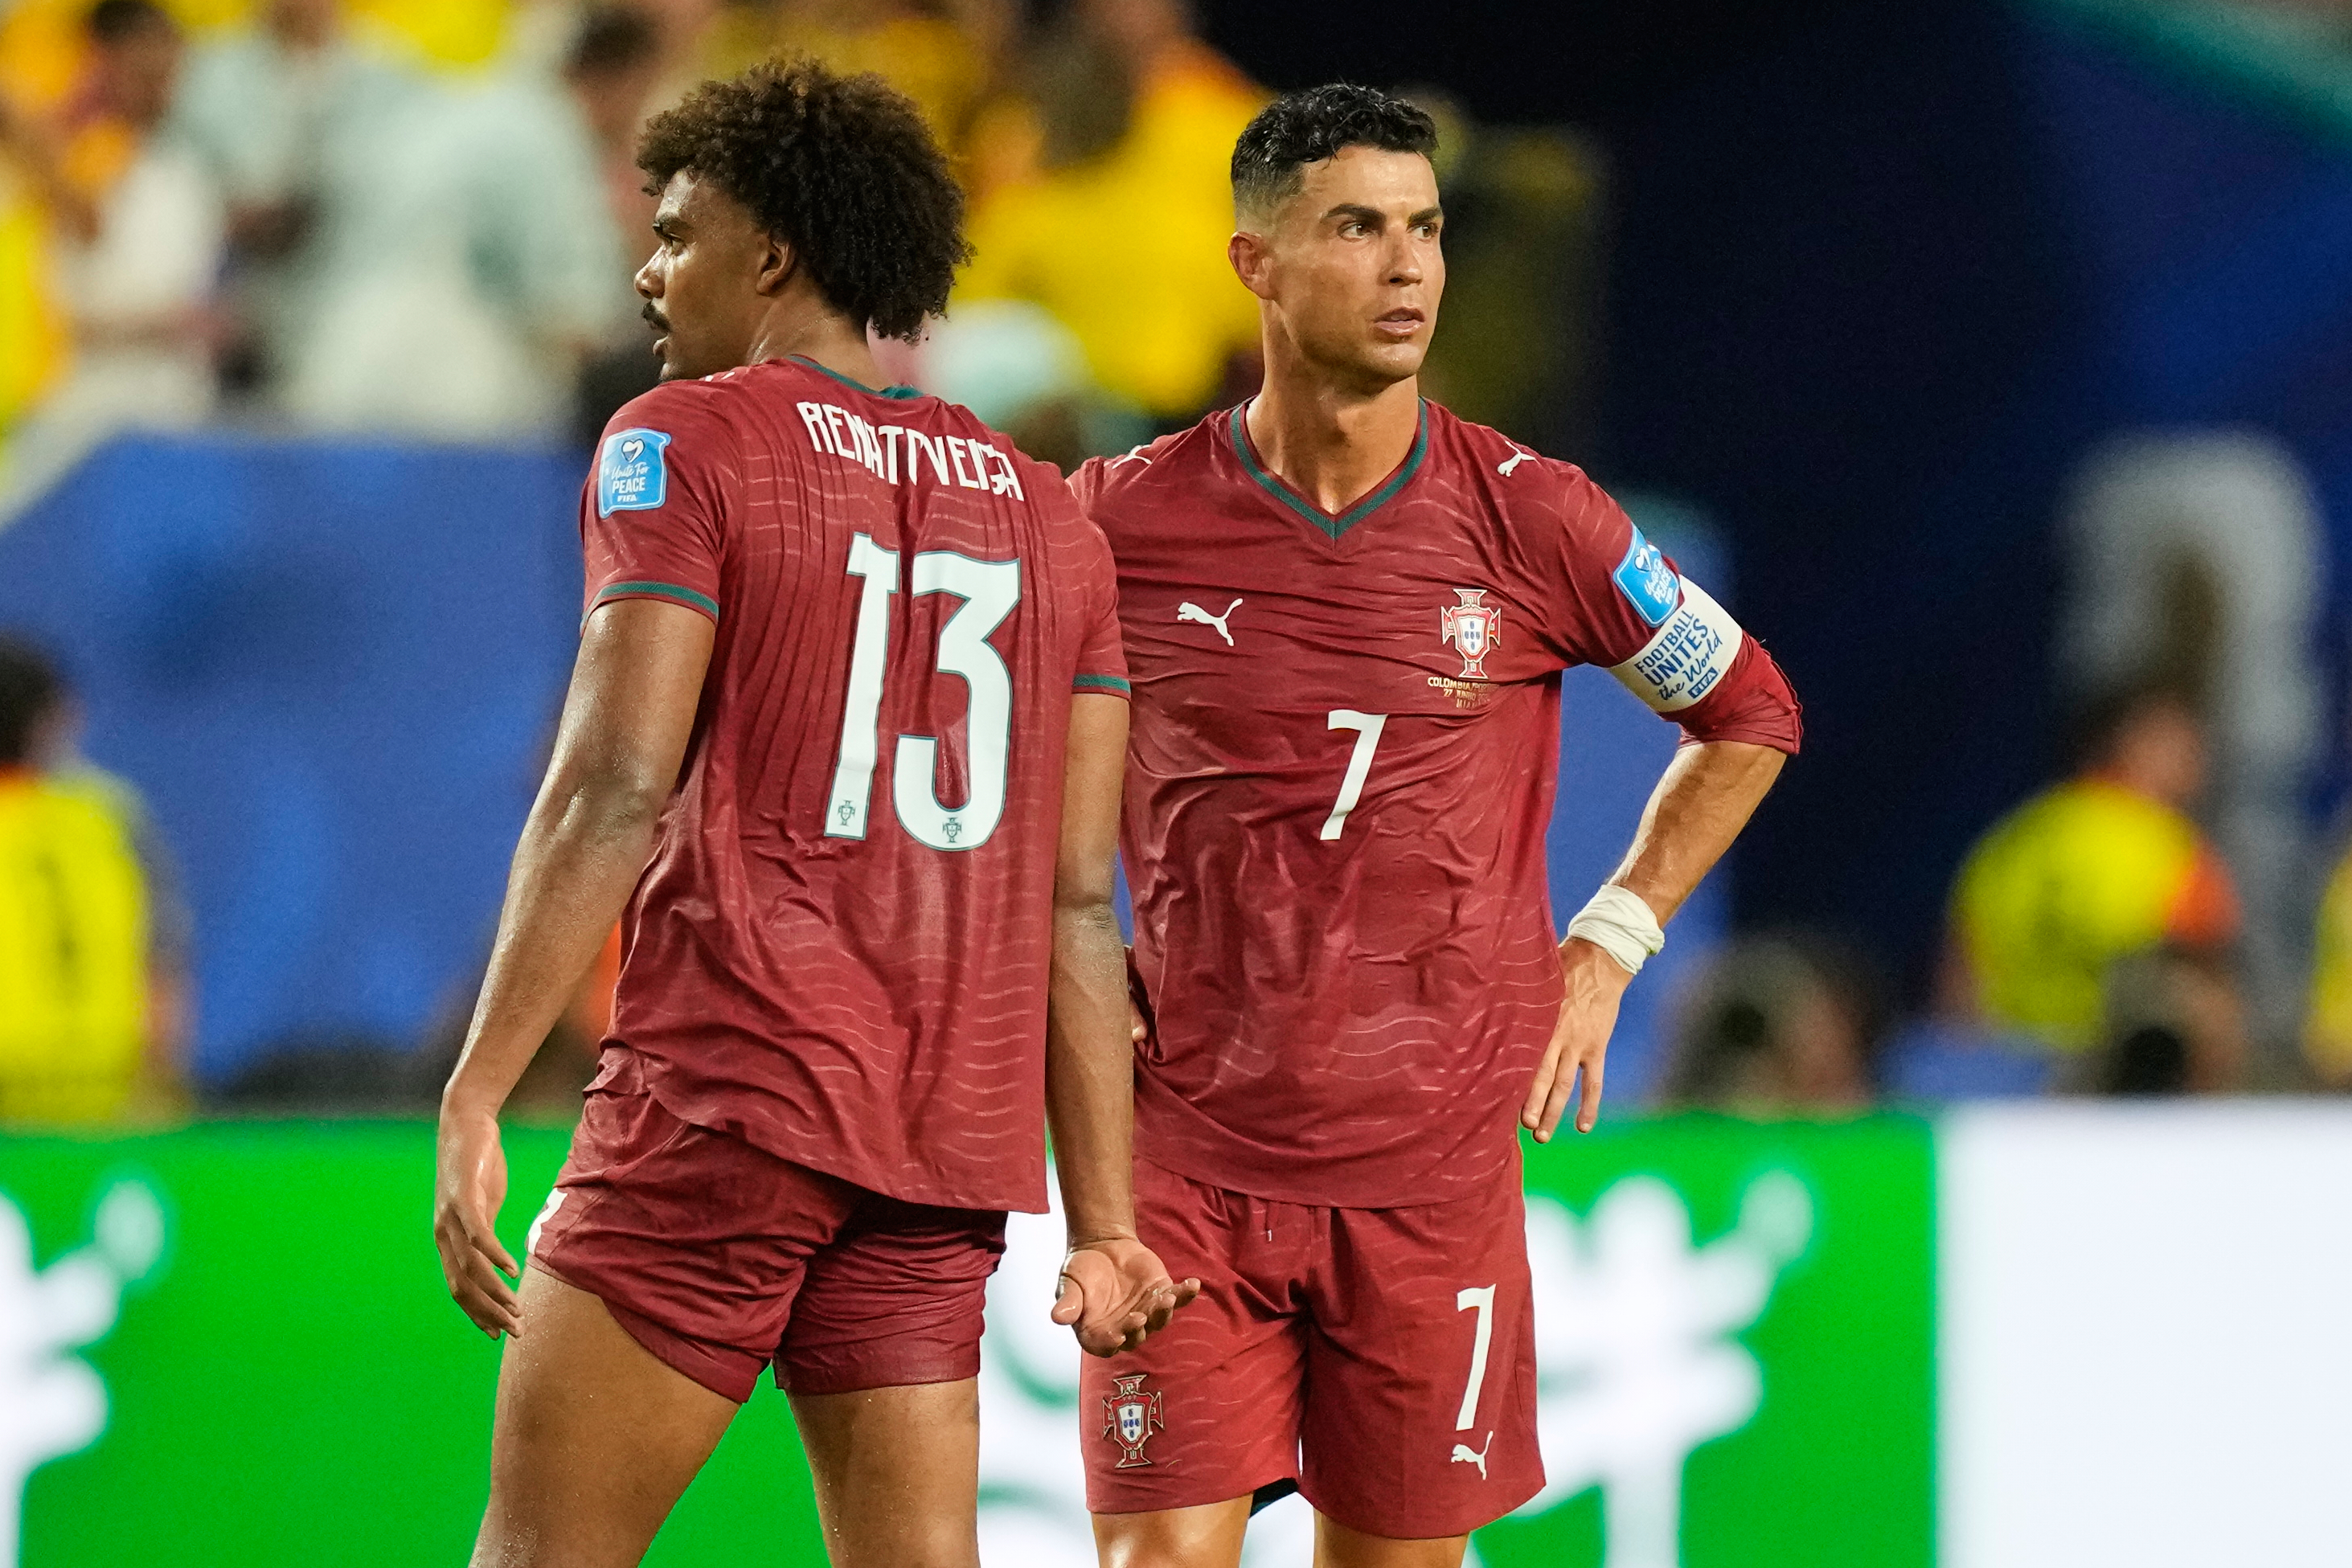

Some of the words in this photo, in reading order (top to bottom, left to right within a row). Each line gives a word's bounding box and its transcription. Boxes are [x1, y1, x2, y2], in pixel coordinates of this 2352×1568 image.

[611, 464, 634, 481] Unite
[635, 461, 650, 477] For
[612, 477, 646, 494] PEACE
[617, 494, 637, 502] FIFA
[922, 435, 1024, 502] VEIGA
[1653, 567, 1672, 604] PEACE
[1633, 610, 1694, 673] FOOTBALL
[1645, 618, 1709, 686] UNITES
[1657, 682, 1686, 701] the
[1682, 628, 1723, 683] World
[824, 531, 1022, 852] 13
[1690, 669, 1719, 697] FIFA
[1320, 709, 1389, 841] 7
[1456, 1283, 1496, 1431] 7
